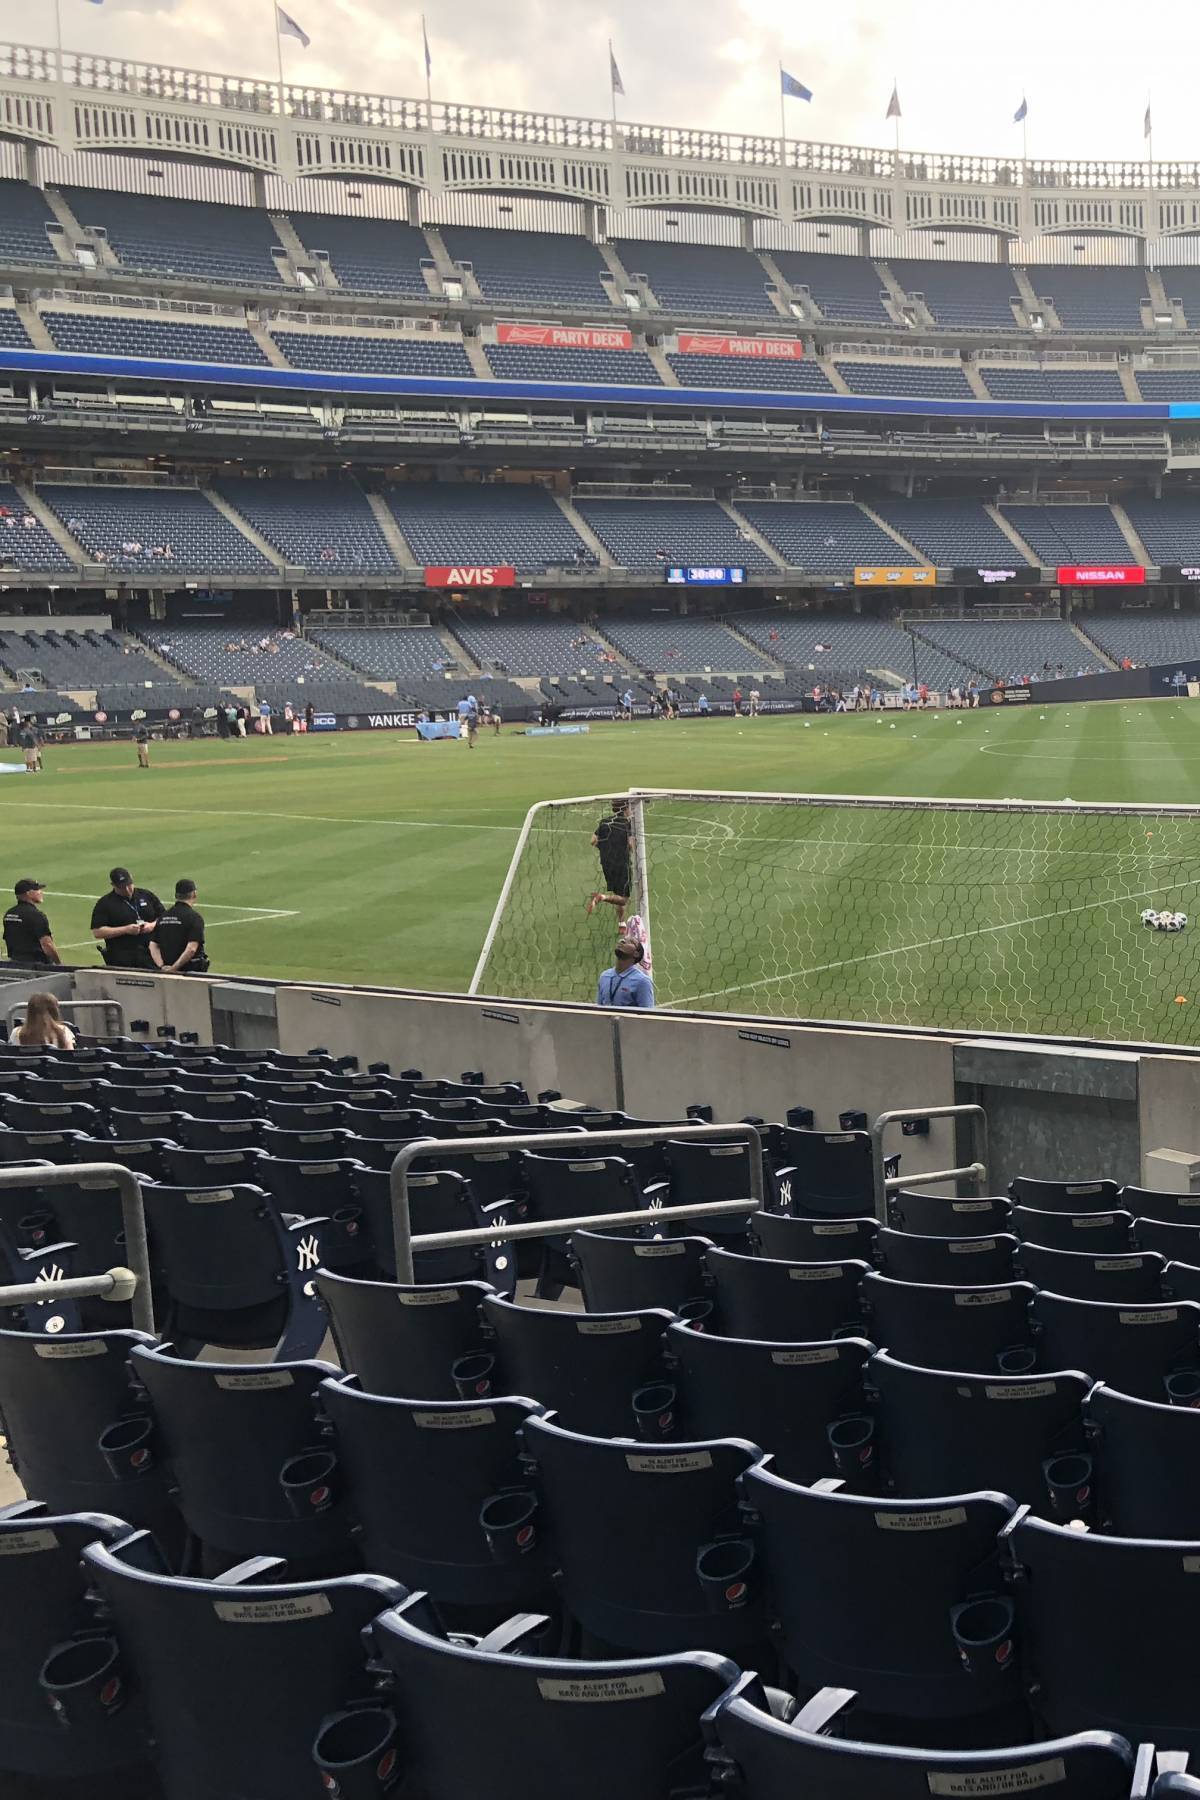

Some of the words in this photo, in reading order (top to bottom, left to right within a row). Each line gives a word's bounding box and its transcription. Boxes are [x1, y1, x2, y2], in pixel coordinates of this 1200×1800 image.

[552, 330, 589, 345] PARTY
[593, 333, 624, 347] DECK
[729, 340, 763, 353] PARTY
[766, 342, 795, 356] DECK
[447, 569, 494, 585] AVIS
[689, 569, 723, 581] 30:00
[1075, 571, 1125, 580] NISSAN
[581, 1689, 616, 1697] AND/OR
[617, 1685, 644, 1695] BALLS
[611, 1681, 627, 1689] FOR
[950, 1784, 974, 1792] BATS
[976, 1781, 1014, 1792] AND/OR
[1016, 1773, 1045, 1786] BALLS
[964, 1777, 976, 1785] BE
[979, 1775, 1007, 1783] ALERT
[1010, 1771, 1028, 1779] FOR
